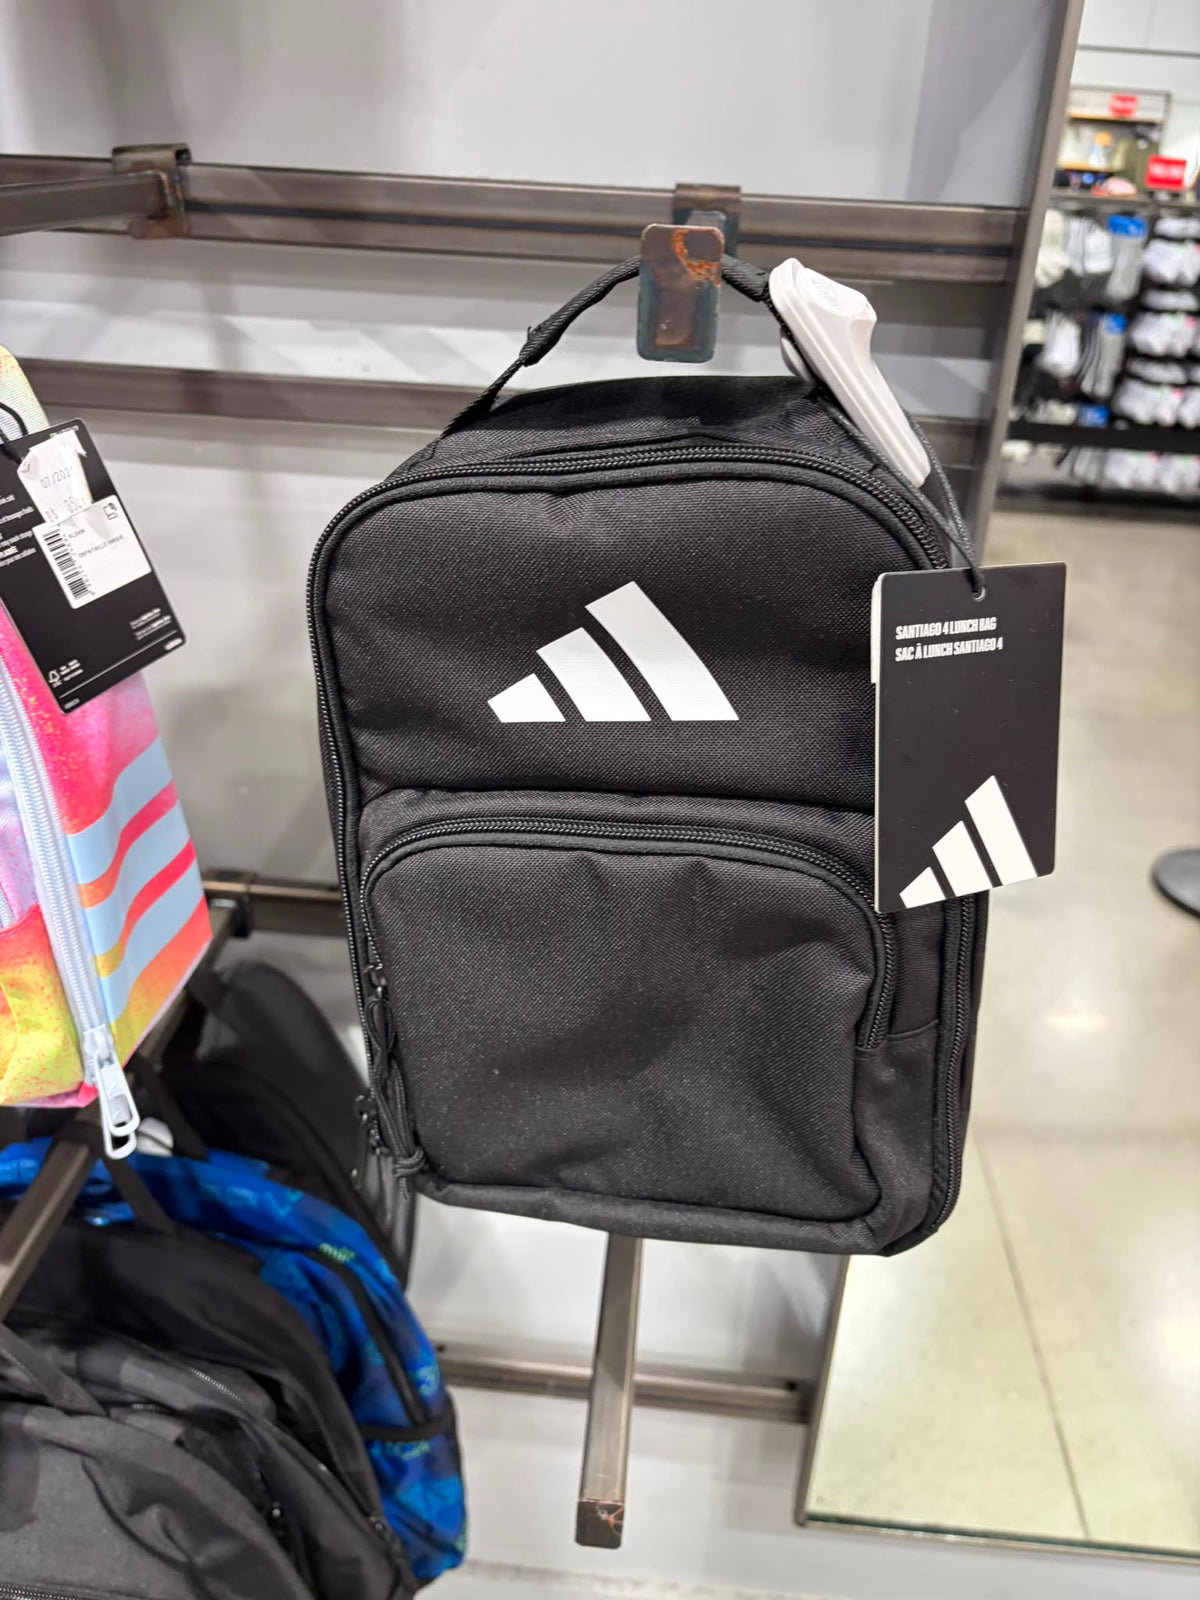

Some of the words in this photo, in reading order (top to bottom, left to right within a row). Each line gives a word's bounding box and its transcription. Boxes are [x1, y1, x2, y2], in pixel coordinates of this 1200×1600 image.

[895, 622, 942, 640] SANTIAGO
[942, 621, 949, 635] 4
[949, 618, 979, 635] LUNCH
[979, 616, 997, 632] BAG
[895, 646, 915, 662] SAC
[914, 642, 922, 660] À
[923, 642, 953, 659] LUNCH
[953, 637, 997, 655] SANTIAGO
[996, 636, 1004, 650] 4
